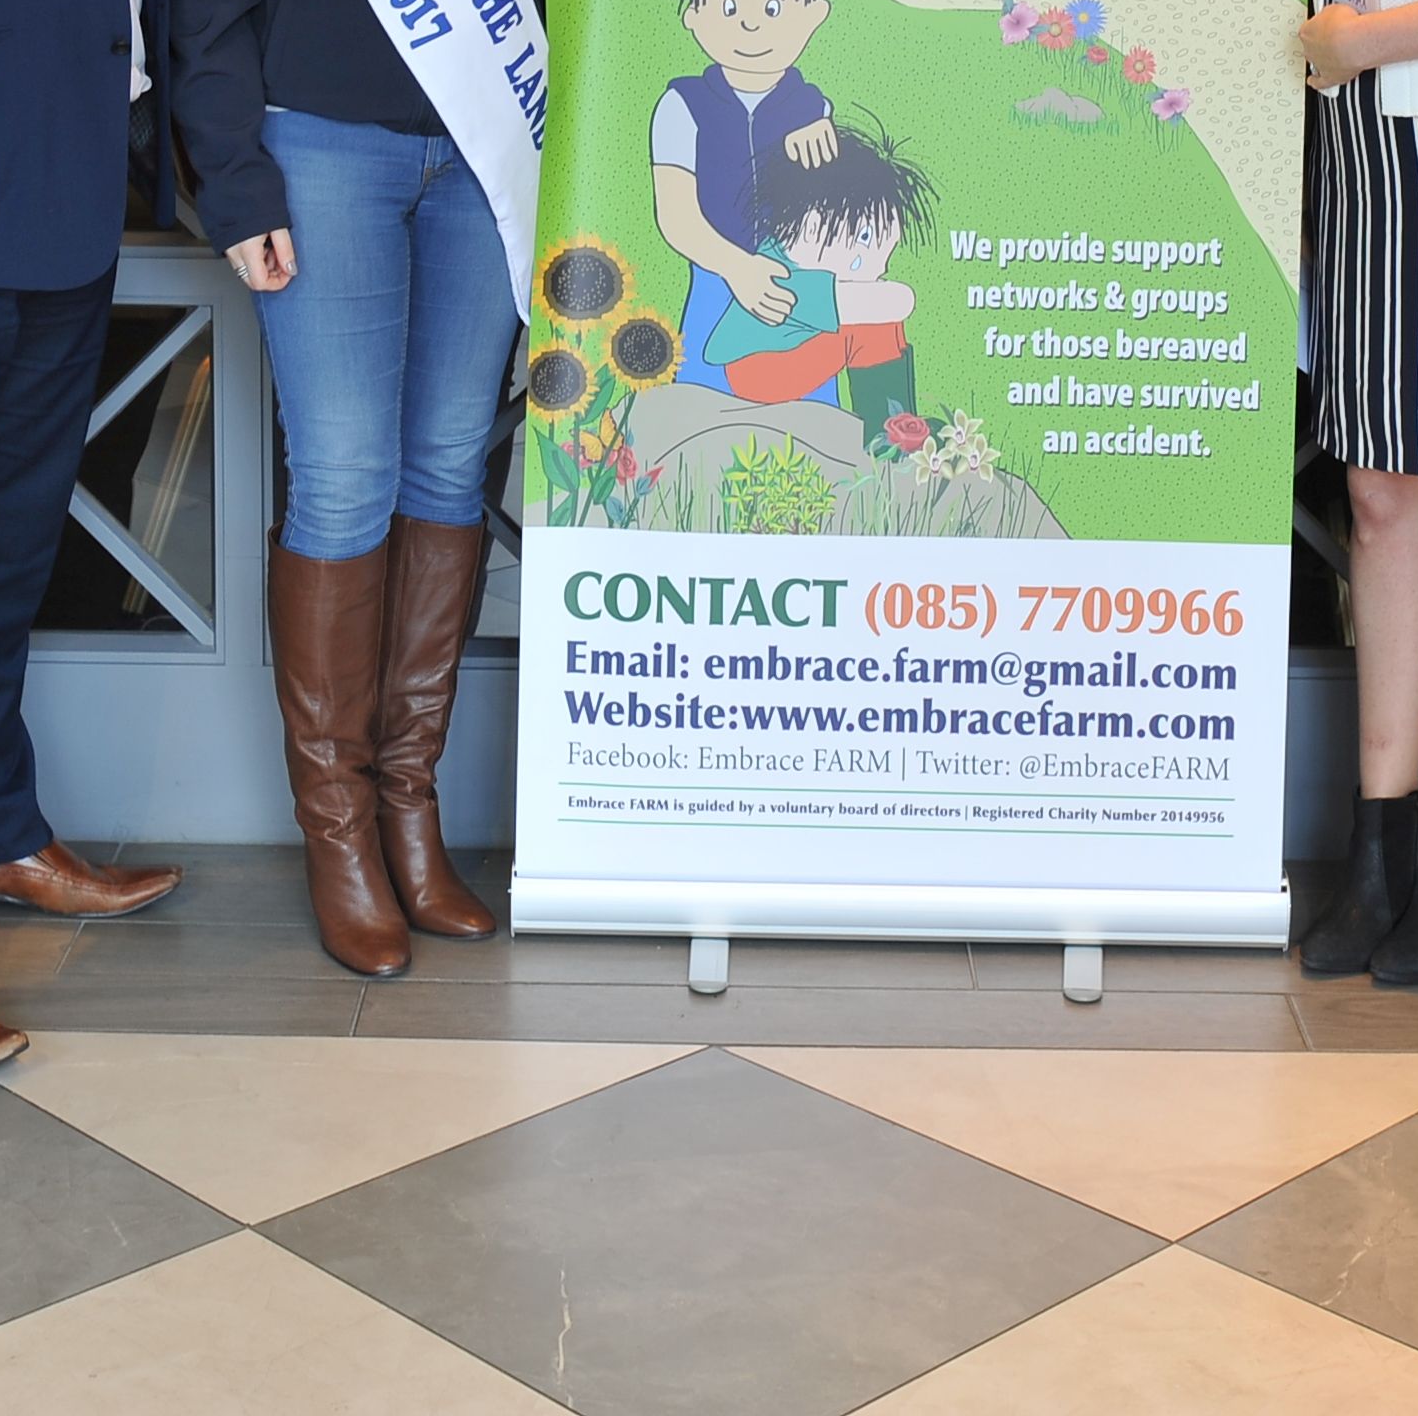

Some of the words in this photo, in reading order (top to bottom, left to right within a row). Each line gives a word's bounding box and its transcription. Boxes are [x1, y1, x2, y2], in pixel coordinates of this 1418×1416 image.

[950, 230, 992, 260] We
[999, 232, 1104, 268] provide
[1111, 237, 1223, 270] support
[967, 280, 1098, 310] networks
[1104, 281, 1125, 310] &
[1131, 288, 1227, 320] groups
[984, 326, 1025, 357] for
[1031, 328, 1109, 358] those
[1116, 328, 1247, 362] bereaved
[1007, 376, 1061, 405] and
[1067, 376, 1133, 406] have
[1140, 378, 1260, 410] survived
[1043, 430, 1077, 454] an
[1084, 425, 1211, 457] accident.
[563, 570, 849, 628] CONTACT
[864, 581, 998, 638] (085)
[1017, 586, 1244, 637] 7709966
[565, 640, 691, 680] Email:
[703, 647, 1237, 696] embrace.farm@gmail.com
[563, 690, 1237, 741] Website:www.embracefarm.com
[567, 741, 689, 770] Facebook:
[697, 746, 805, 772] Embrace
[813, 748, 891, 774] FARM
[915, 750, 1011, 776] Twitter:
[1019, 753, 1230, 782] @EmbraceFARM
[569, 796, 625, 810] Embrace
[630, 798, 669, 810] FARM
[673, 798, 684, 811] is
[688, 800, 734, 815] guided
[739, 800, 755, 816] by
[759, 804, 765, 812] a
[770, 800, 834, 817] voluntary
[839, 802, 879, 816] board
[883, 803, 897, 816] of
[901, 804, 961, 818] directors
[973, 806, 1043, 821] Registered
[1049, 806, 1097, 824] Charity
[1101, 808, 1157, 822] Number
[1161, 810, 1225, 823] 20149956
